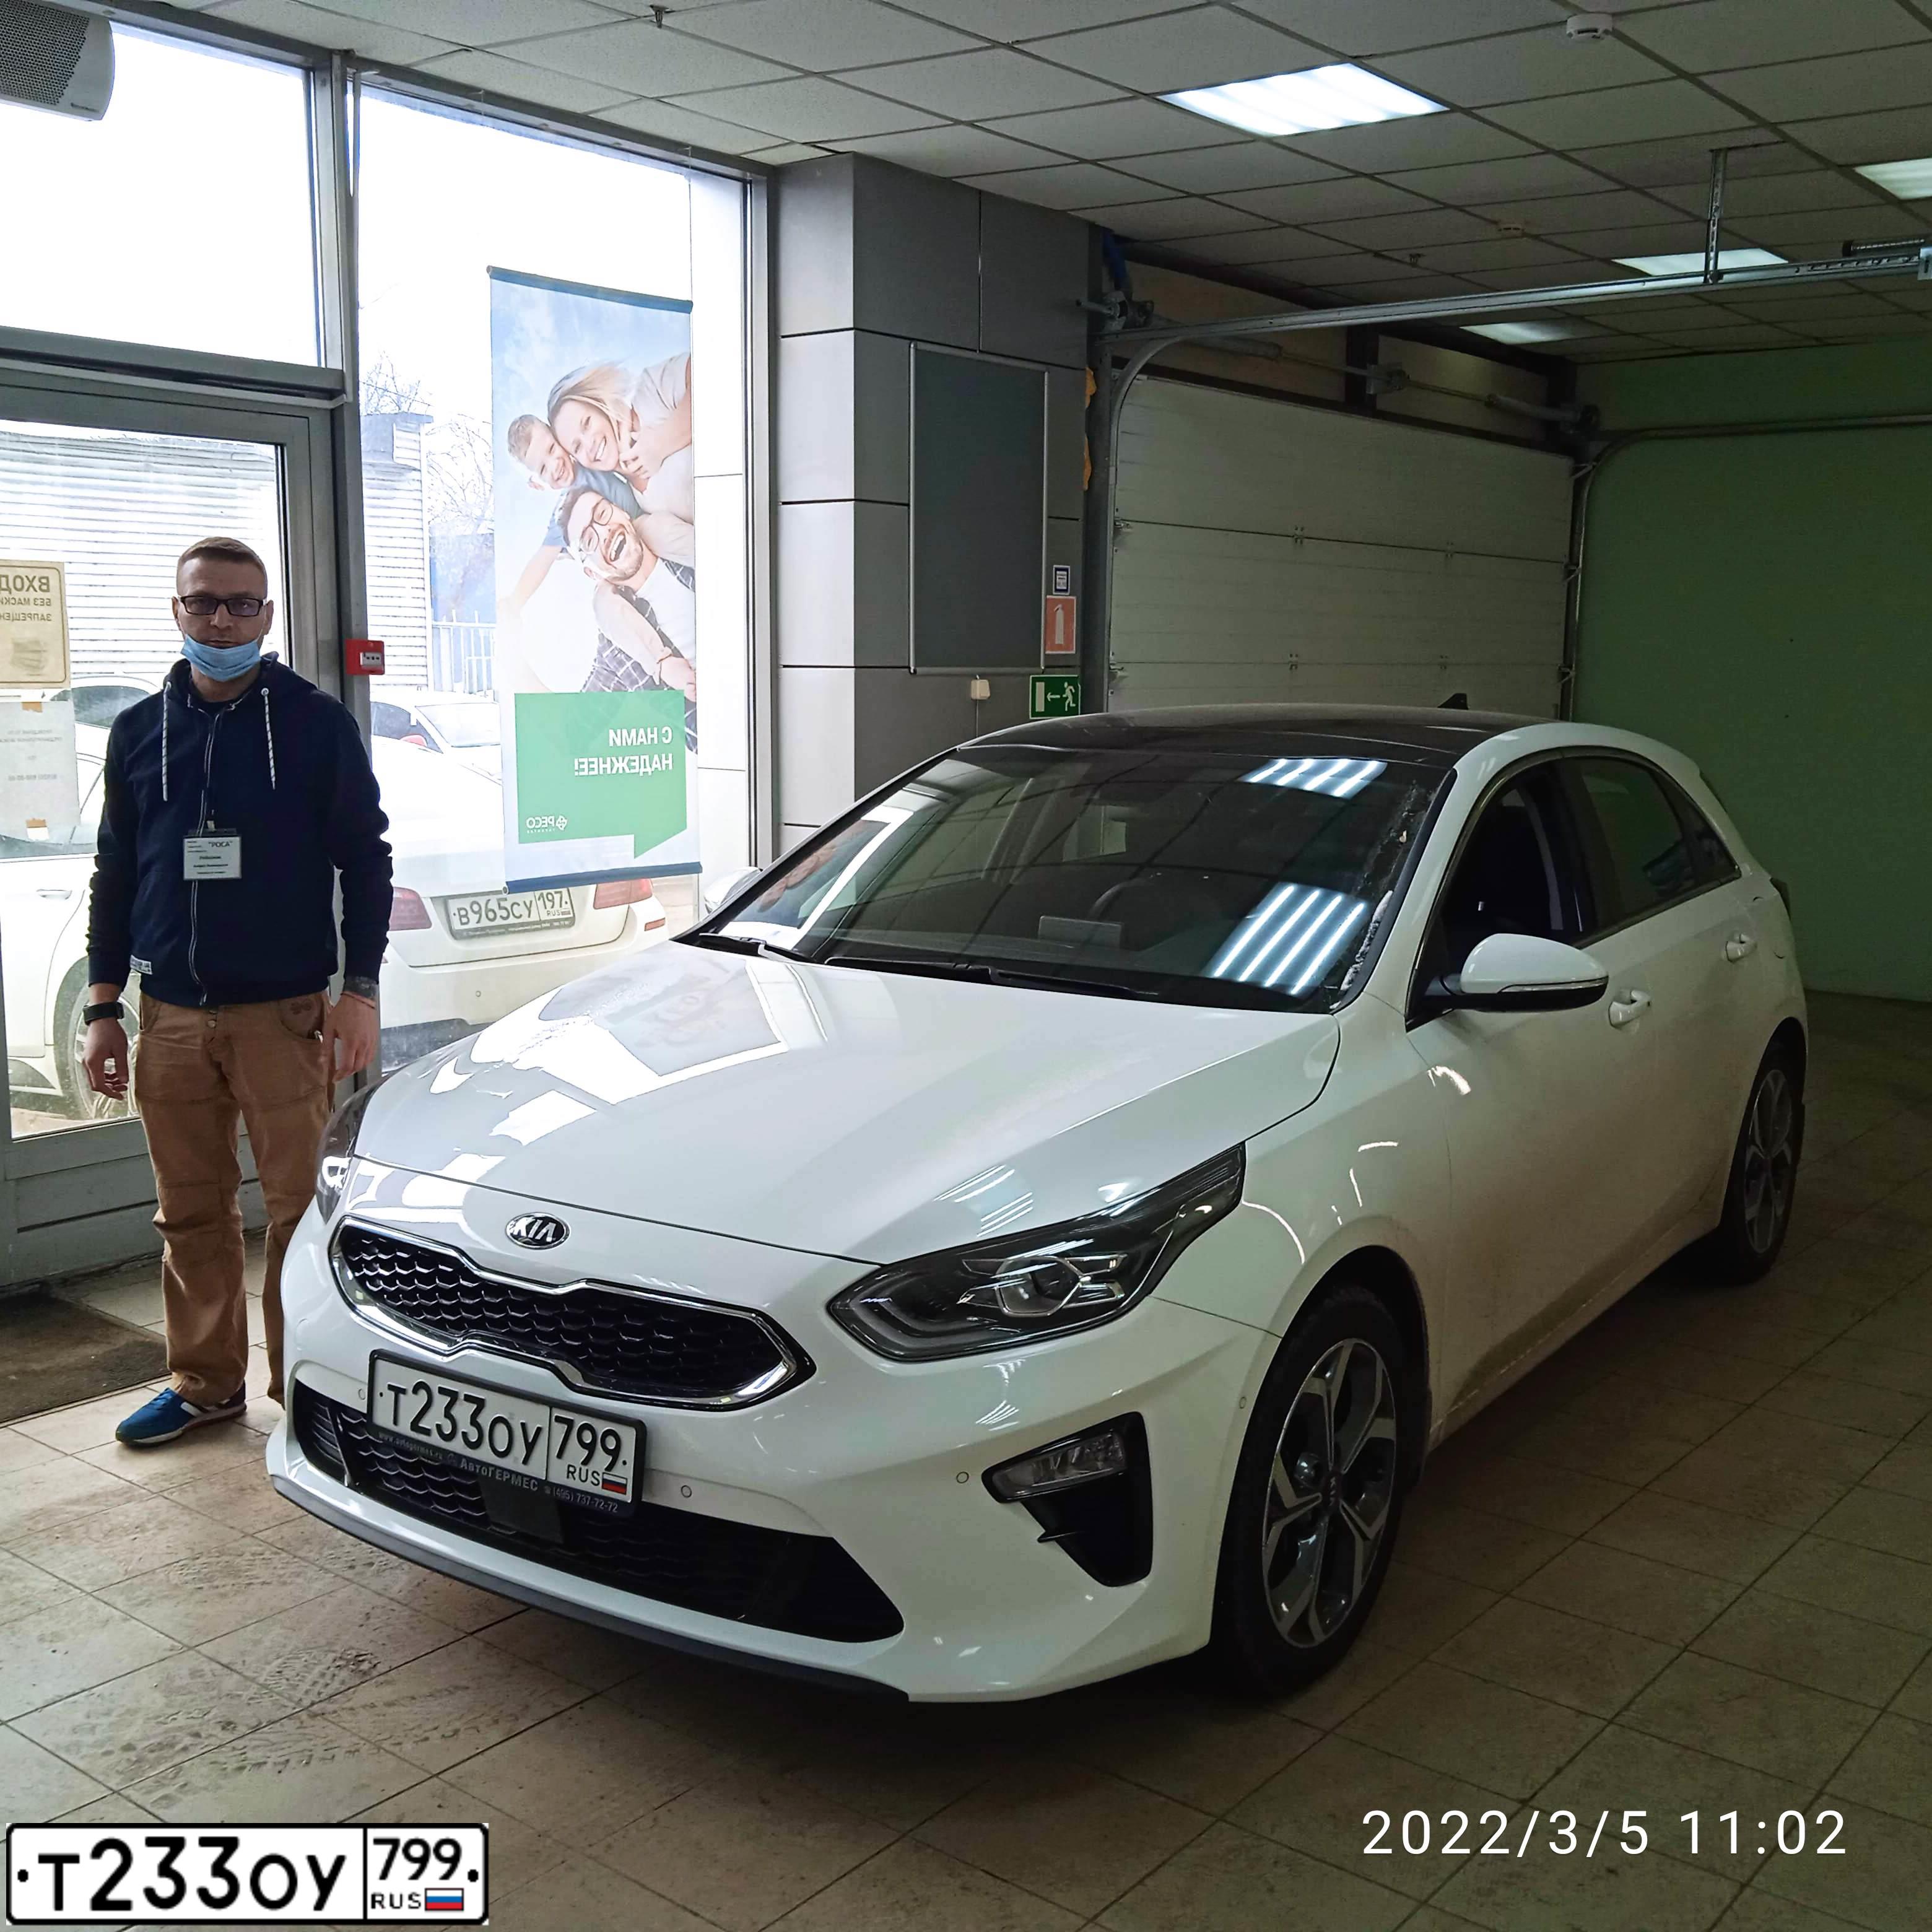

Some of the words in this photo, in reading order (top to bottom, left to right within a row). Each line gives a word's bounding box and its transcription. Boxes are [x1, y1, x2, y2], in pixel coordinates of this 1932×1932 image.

[457, 899, 533, 926] В965СУ
[538, 890, 563, 910] 197
[513, 1216, 557, 1242] KIA
[387, 1380, 542, 1465] Т233ОУ
[554, 1415, 620, 1473] 799
[567, 1464, 600, 1486] RUS
